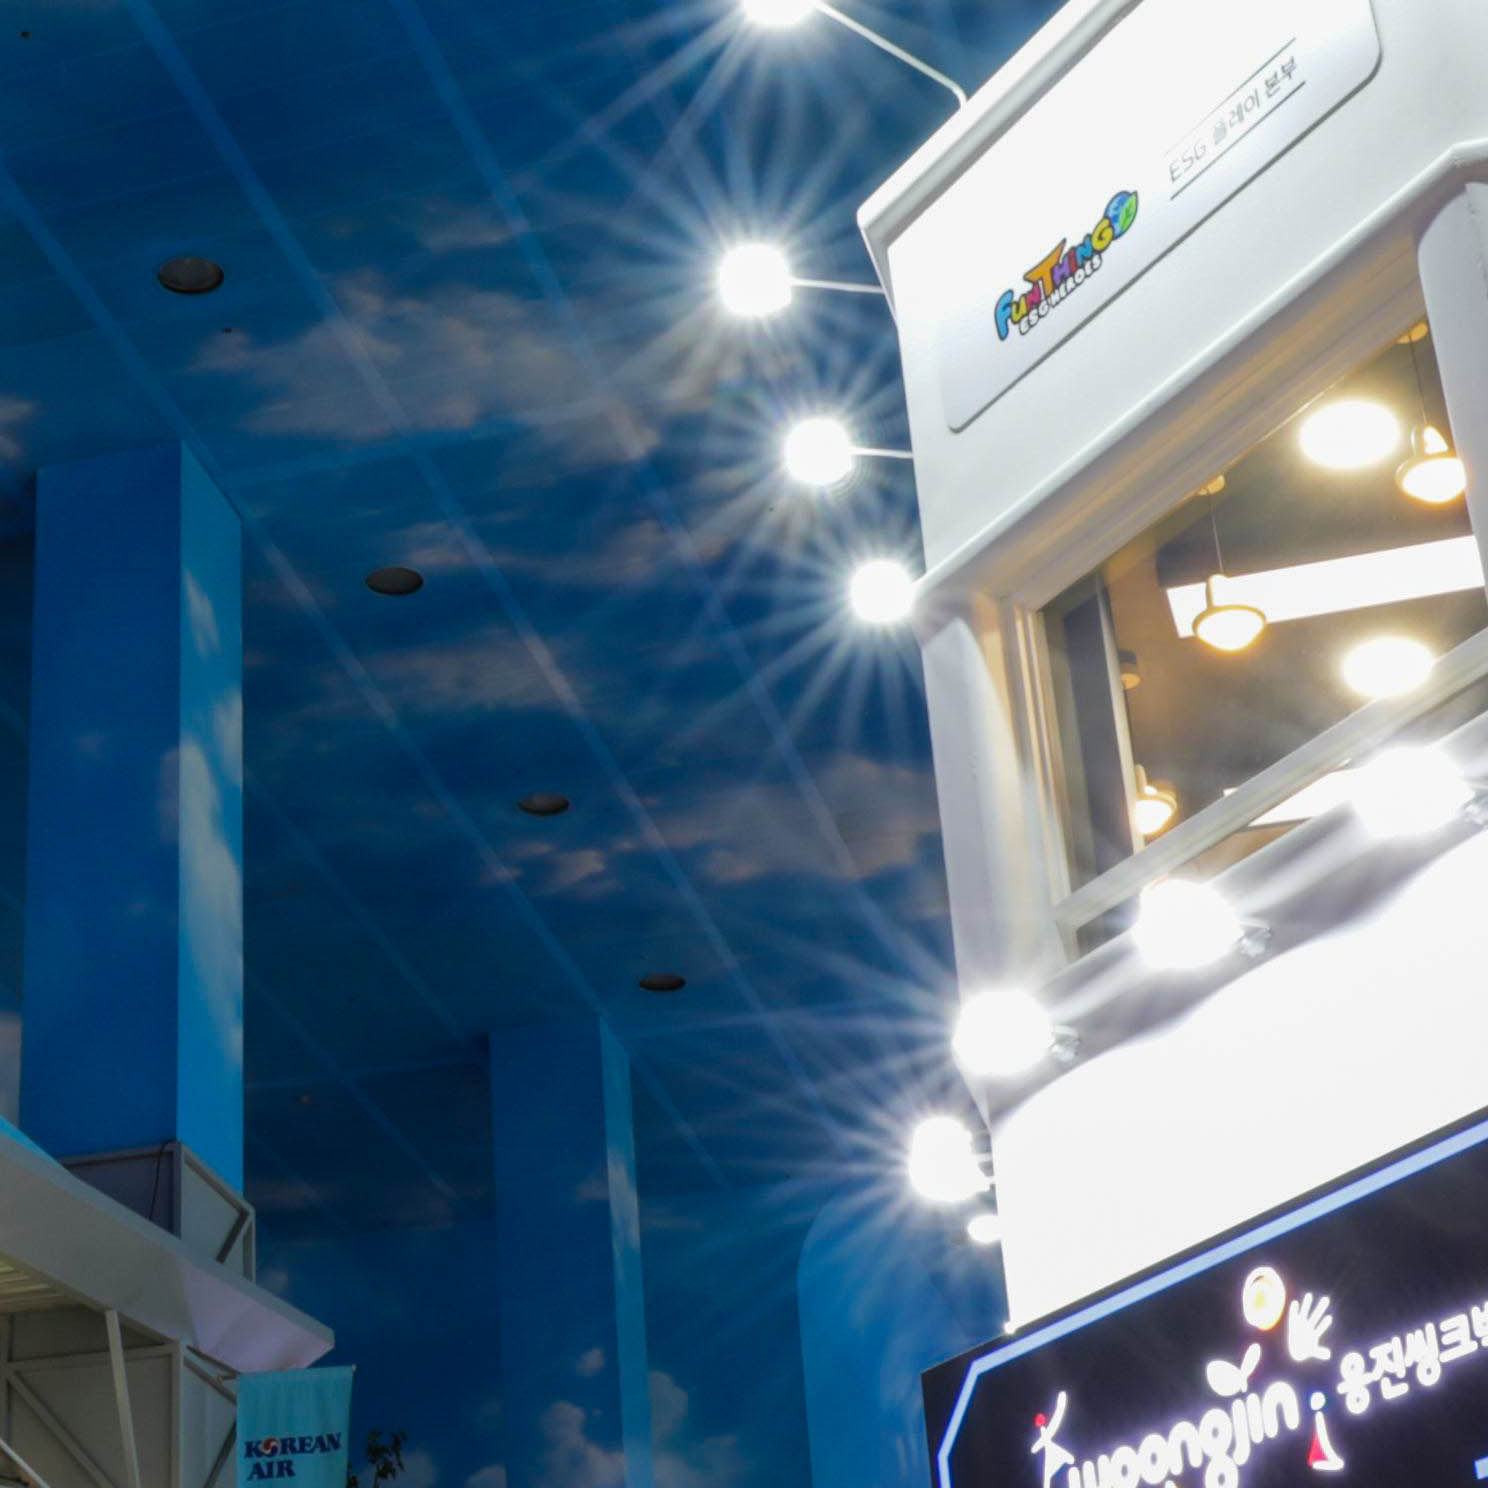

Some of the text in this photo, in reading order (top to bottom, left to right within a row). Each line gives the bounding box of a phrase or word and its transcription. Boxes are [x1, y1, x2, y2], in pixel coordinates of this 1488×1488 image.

[1168, 142, 1207, 183] ESG
[1264, 55, 1299, 100] 본부
[244, 1432, 342, 1459] KOREAN
[247, 1459, 296, 1481] AIR
